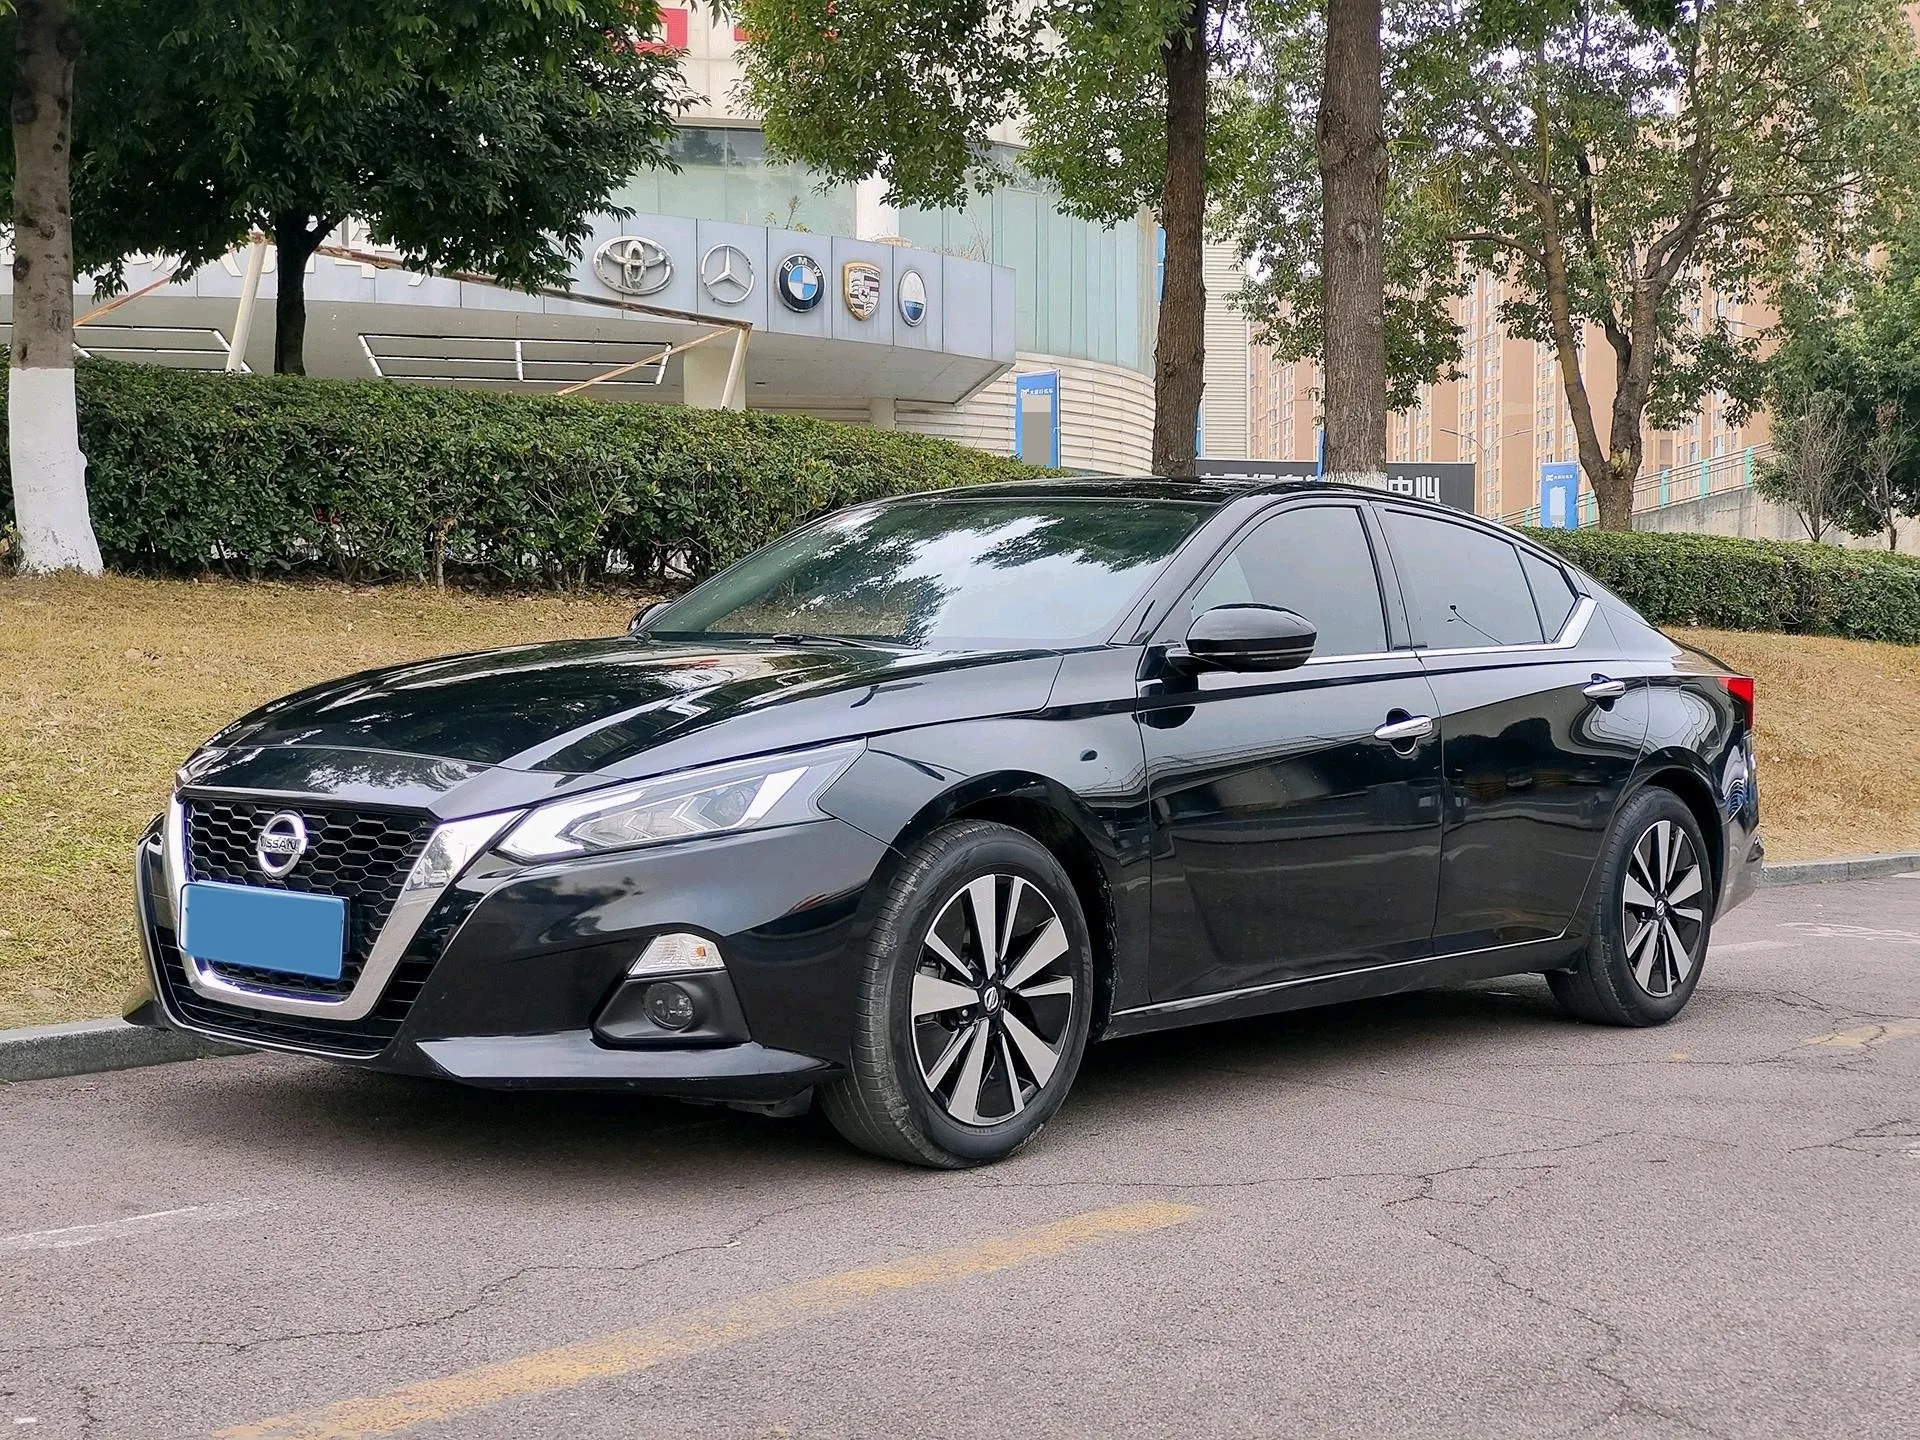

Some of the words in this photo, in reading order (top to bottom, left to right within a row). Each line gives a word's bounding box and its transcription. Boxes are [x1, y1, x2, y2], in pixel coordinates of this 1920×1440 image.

[783, 256, 822, 278] BMW
[1388, 475, 1441, 503] 中心
[259, 835, 298, 850] NISSAN
